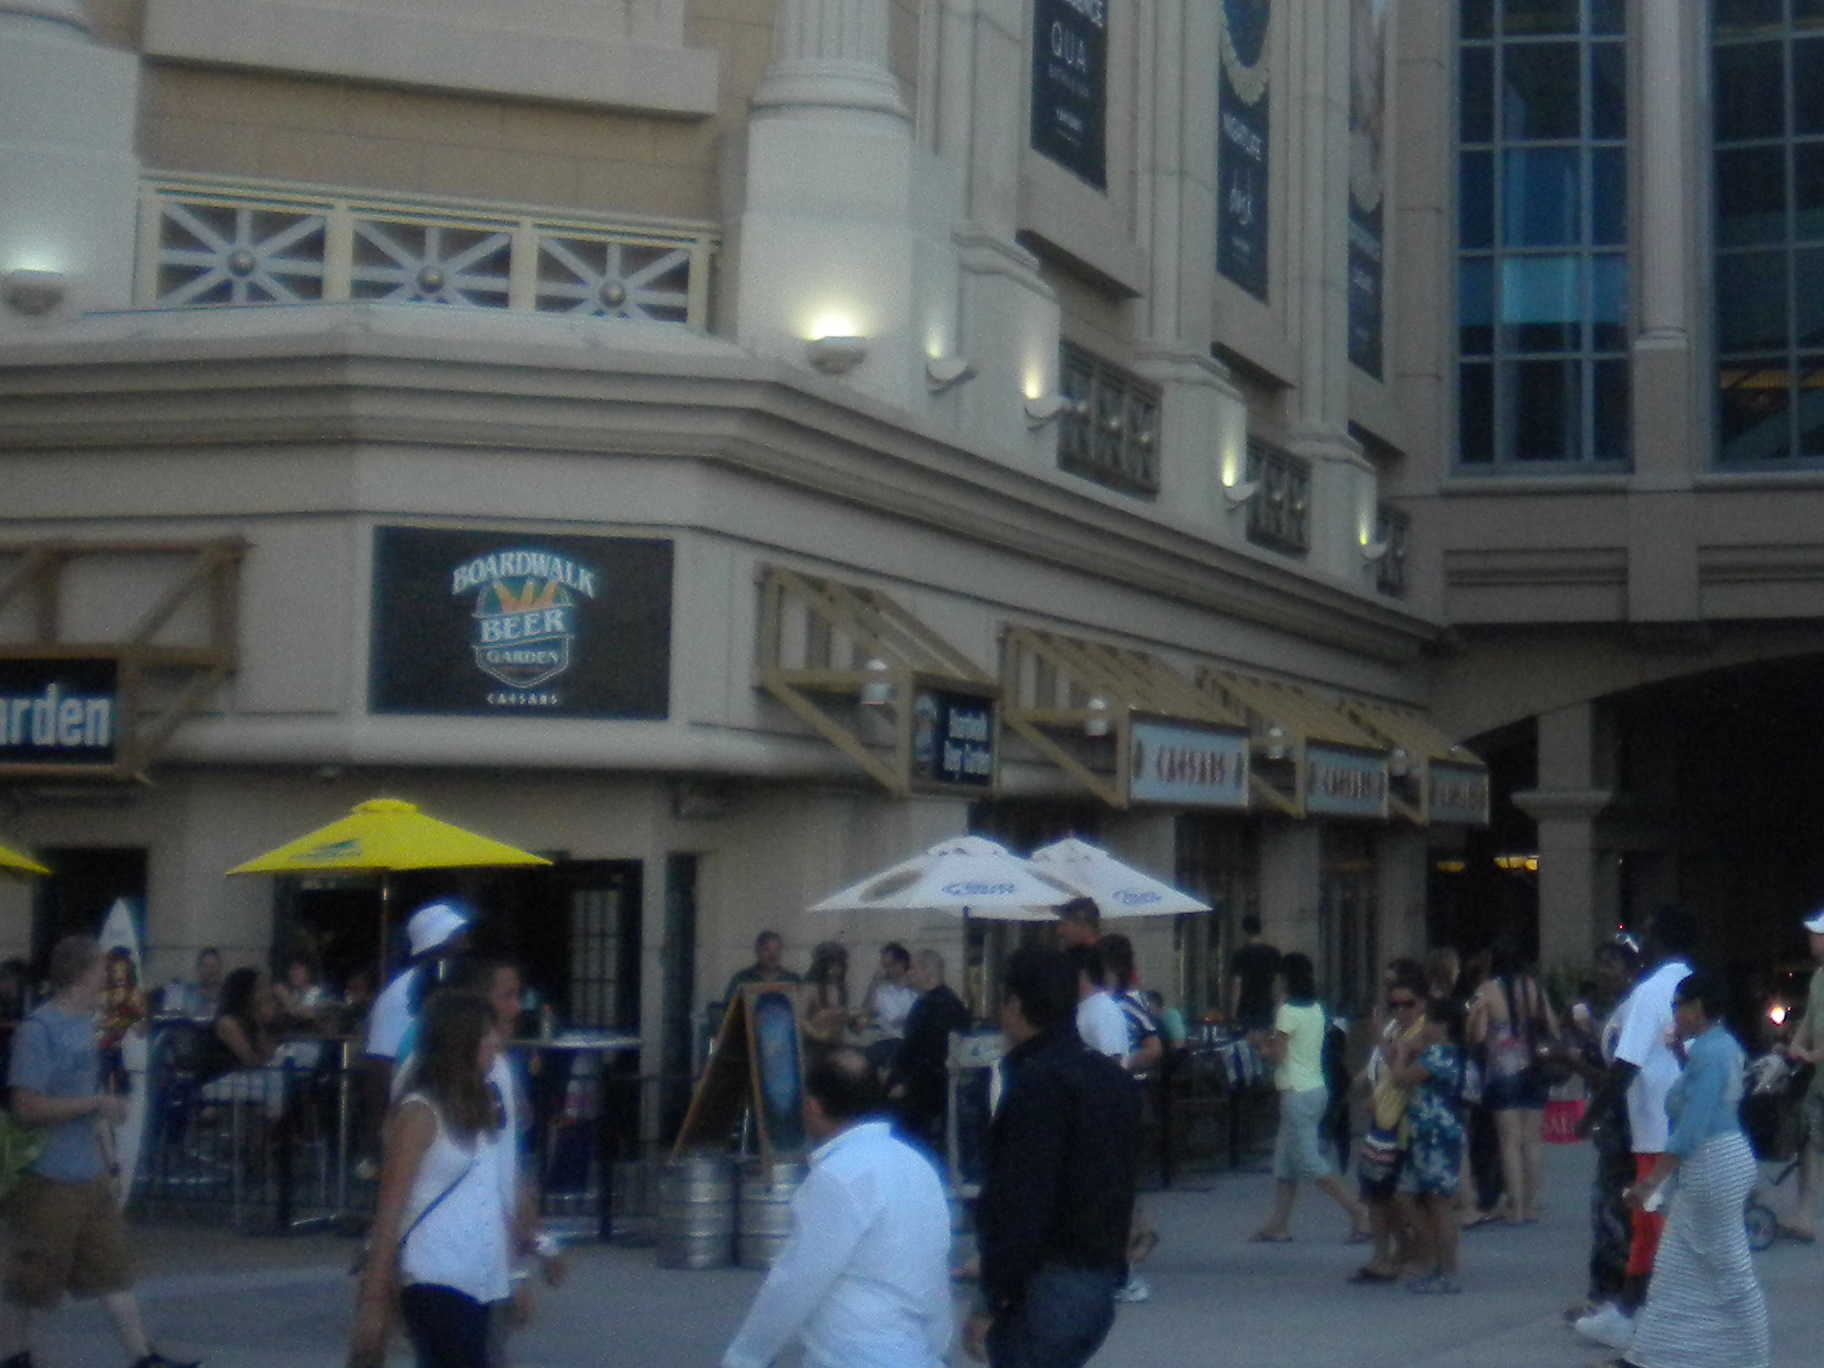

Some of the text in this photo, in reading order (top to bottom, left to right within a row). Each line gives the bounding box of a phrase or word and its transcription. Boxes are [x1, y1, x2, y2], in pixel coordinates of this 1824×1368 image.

[452, 550, 596, 600] BOARDWALK
[480, 608, 567, 643] BEER
[485, 649, 560, 665] GARDEN
[0, 683, 111, 746] rden
[486, 693, 561, 706] CAESARS
